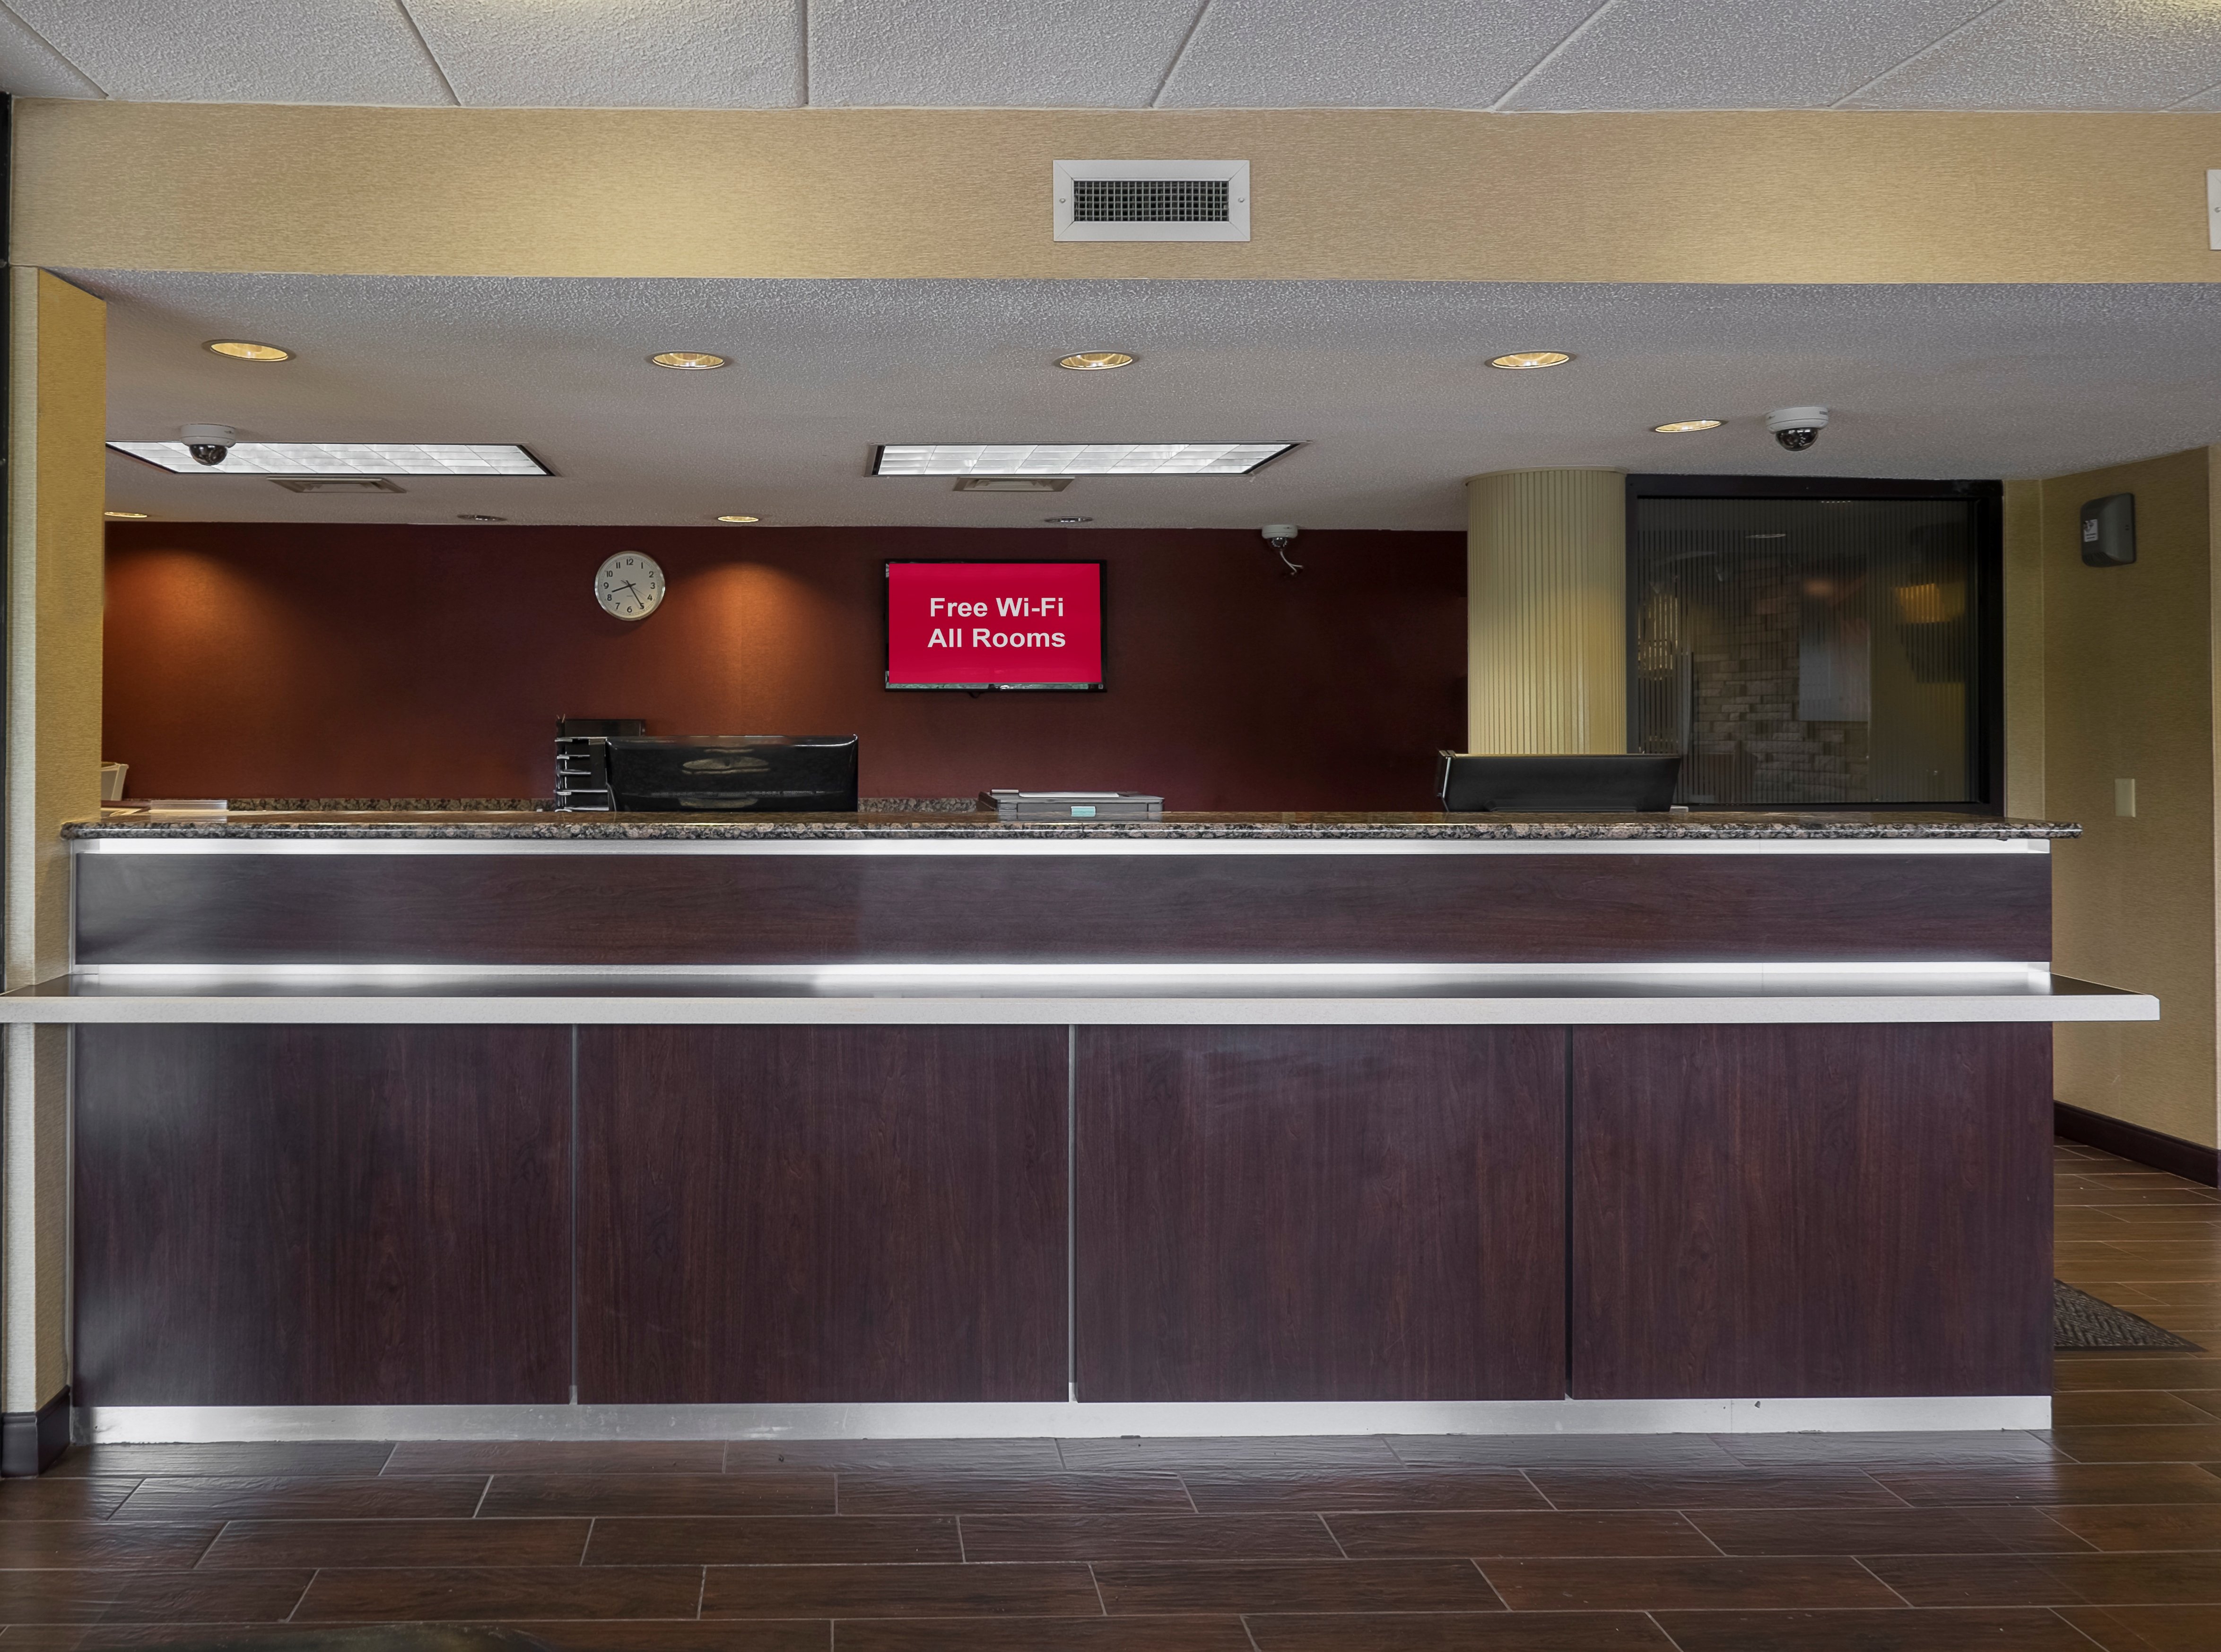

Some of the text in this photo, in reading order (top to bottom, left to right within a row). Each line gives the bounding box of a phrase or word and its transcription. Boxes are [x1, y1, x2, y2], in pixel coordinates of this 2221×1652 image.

[615, 602, 620, 610] 7
[930, 597, 1063, 617] Free Wi-Fi
[927, 628, 1066, 648] All Rooms
